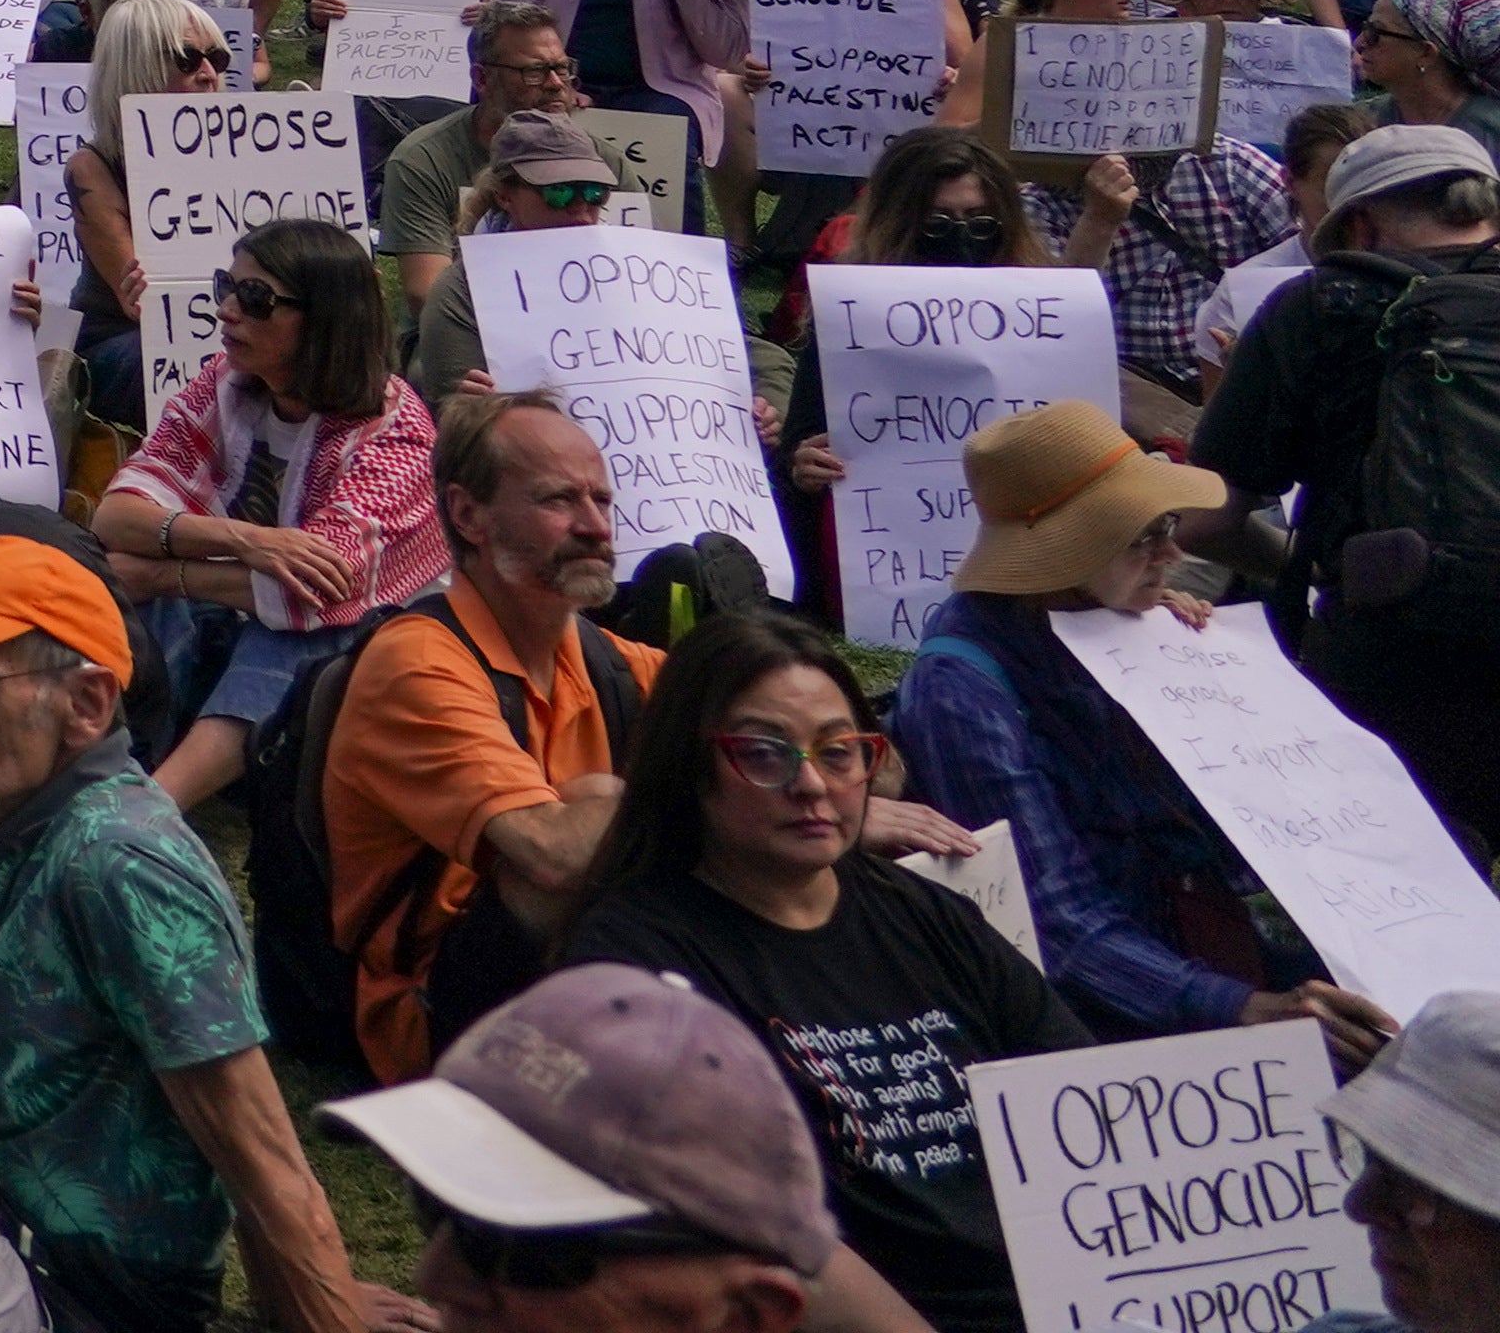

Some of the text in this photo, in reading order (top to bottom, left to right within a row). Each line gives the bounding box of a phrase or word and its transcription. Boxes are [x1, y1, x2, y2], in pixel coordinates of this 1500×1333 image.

[337, 29, 446, 43] SUPPORT
[1026, 27, 1194, 56] I OPPOSE
[335, 43, 462, 64] PALESTINE
[791, 45, 935, 76] SUPPORT
[349, 63, 435, 81] ACTION
[1039, 59, 1200, 92] GENOCIDE
[767, 80, 938, 117] PALESTINE
[1064, 97, 1196, 118] SUPPORT
[1121, 121, 1187, 147] ACTION
[558, 254, 723, 312] OPPOSE
[887, 296, 1064, 347] OPPOSE
[548, 327, 742, 374] GENOCIDE
[877, 1022, 907, 1043] in
[845, 1034, 949, 1078] for good,
[873, 1069, 943, 1105] against
[869, 1116, 914, 1141] with
[1052, 1060, 1303, 1170] OPPOSE
